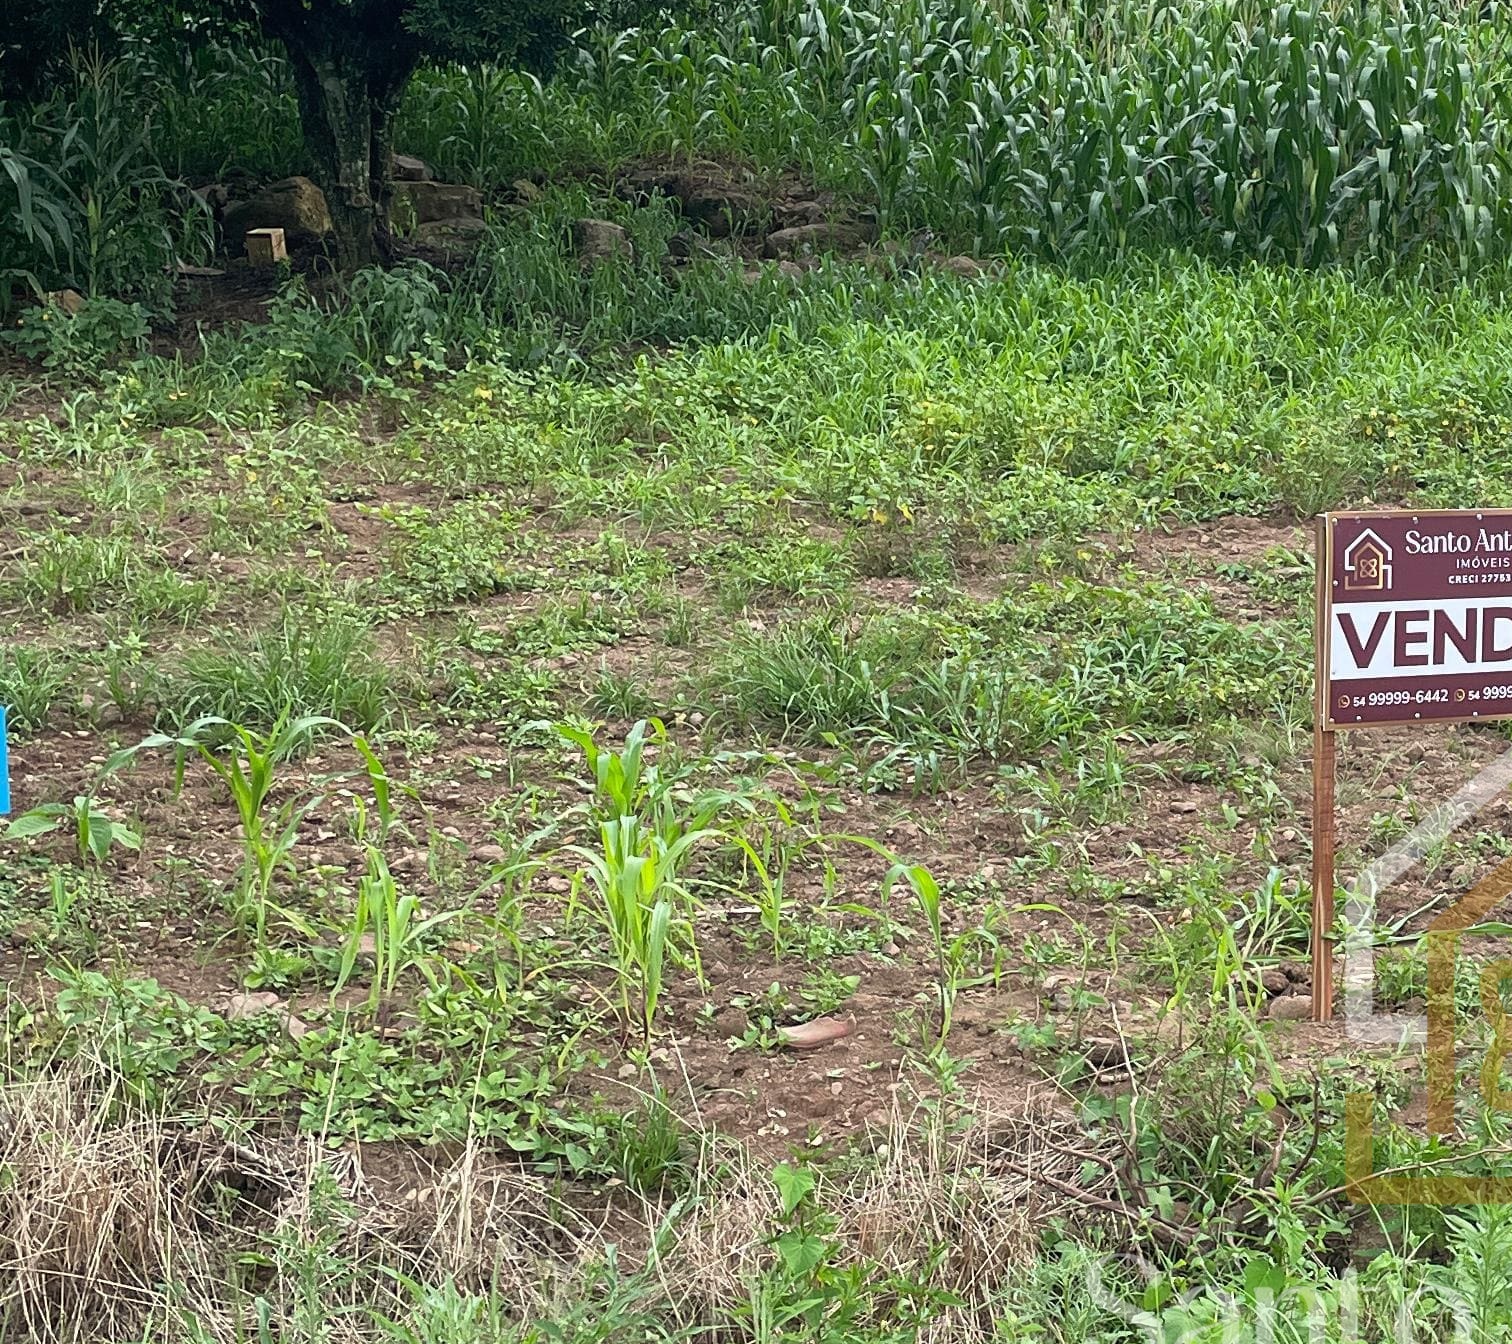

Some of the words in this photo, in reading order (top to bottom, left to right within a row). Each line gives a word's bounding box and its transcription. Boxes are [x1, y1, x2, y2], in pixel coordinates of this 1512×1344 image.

[1405, 529, 1471, 554] Santo
[1456, 555, 1511, 569] IMÓVEIS
[1448, 575, 1479, 584] CRECI
[1353, 696, 1366, 707] 54
[1368, 689, 1449, 706] 99999-6442
[1468, 690, 1480, 701] 54
